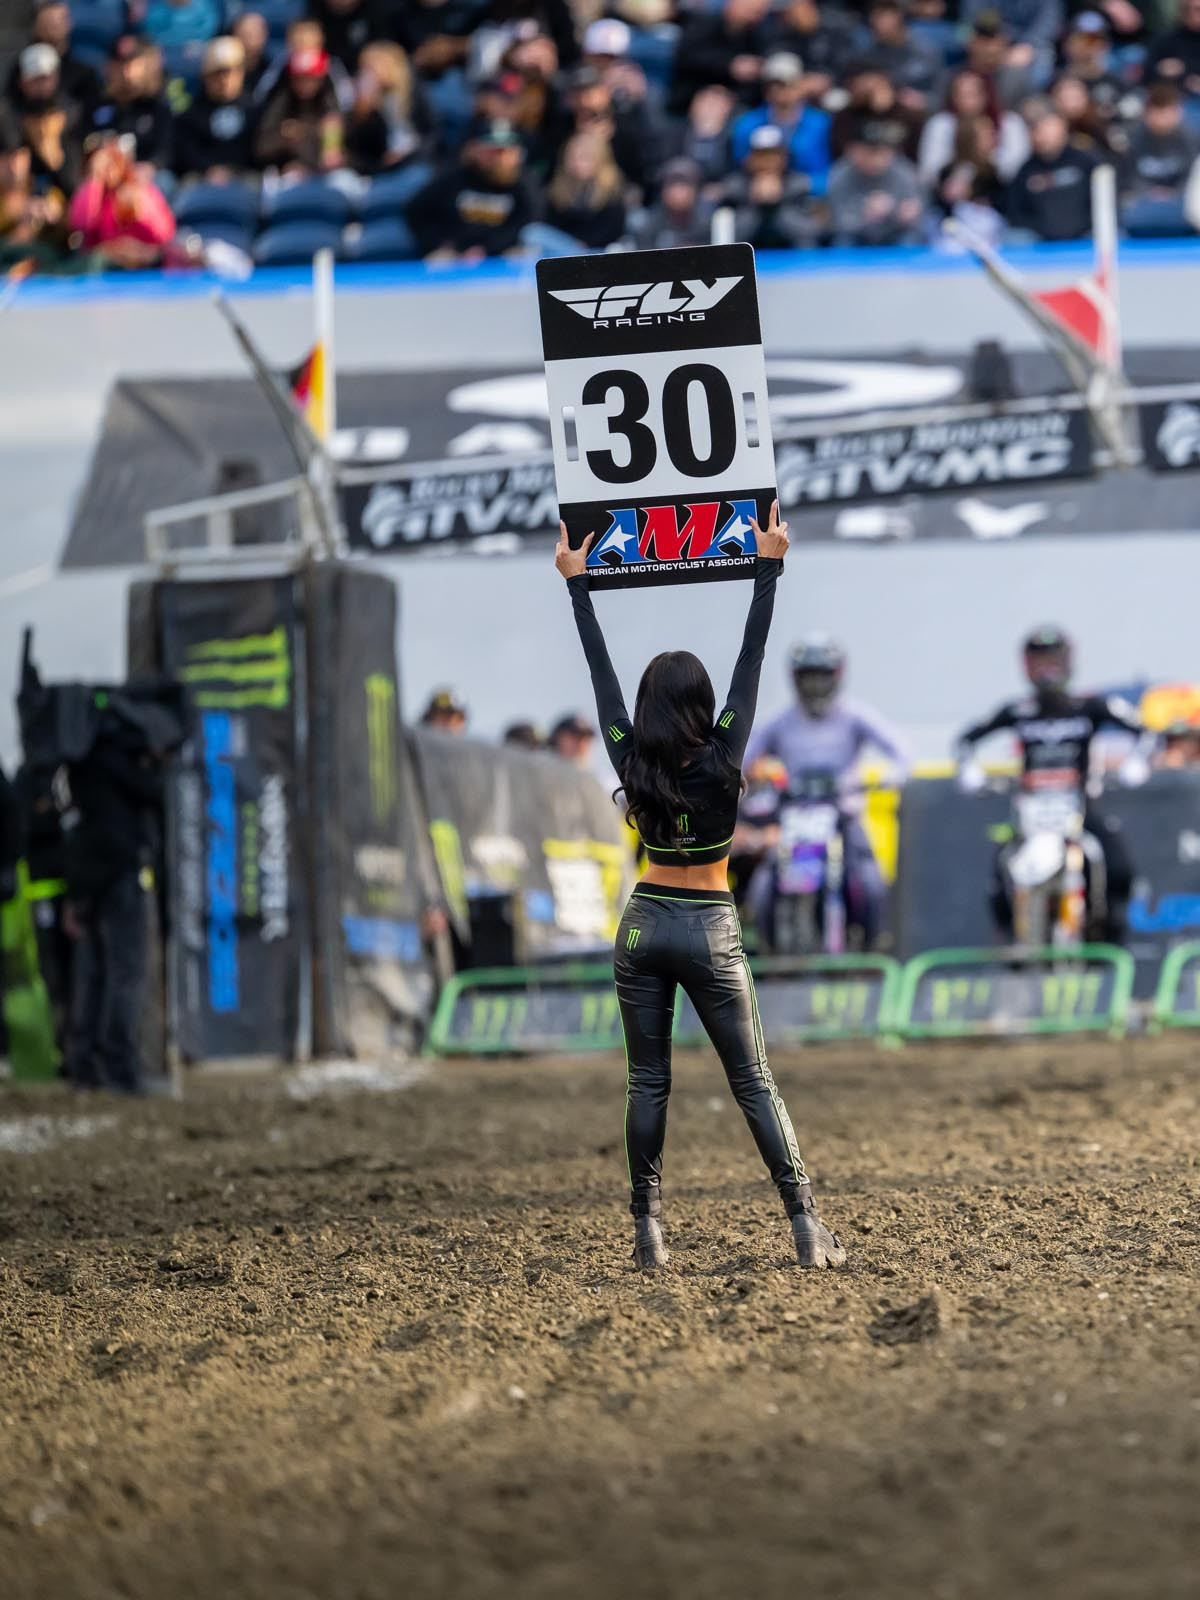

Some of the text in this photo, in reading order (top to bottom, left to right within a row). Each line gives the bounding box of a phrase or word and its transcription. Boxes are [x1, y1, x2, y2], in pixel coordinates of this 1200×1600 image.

[598, 276, 745, 319] FLY
[593, 312, 706, 329] RACING
[582, 363, 738, 484] 30
[586, 499, 758, 566] AMA
[585, 556, 756, 577] MERICAN MOTORCYCLIST ASSOCIAT
